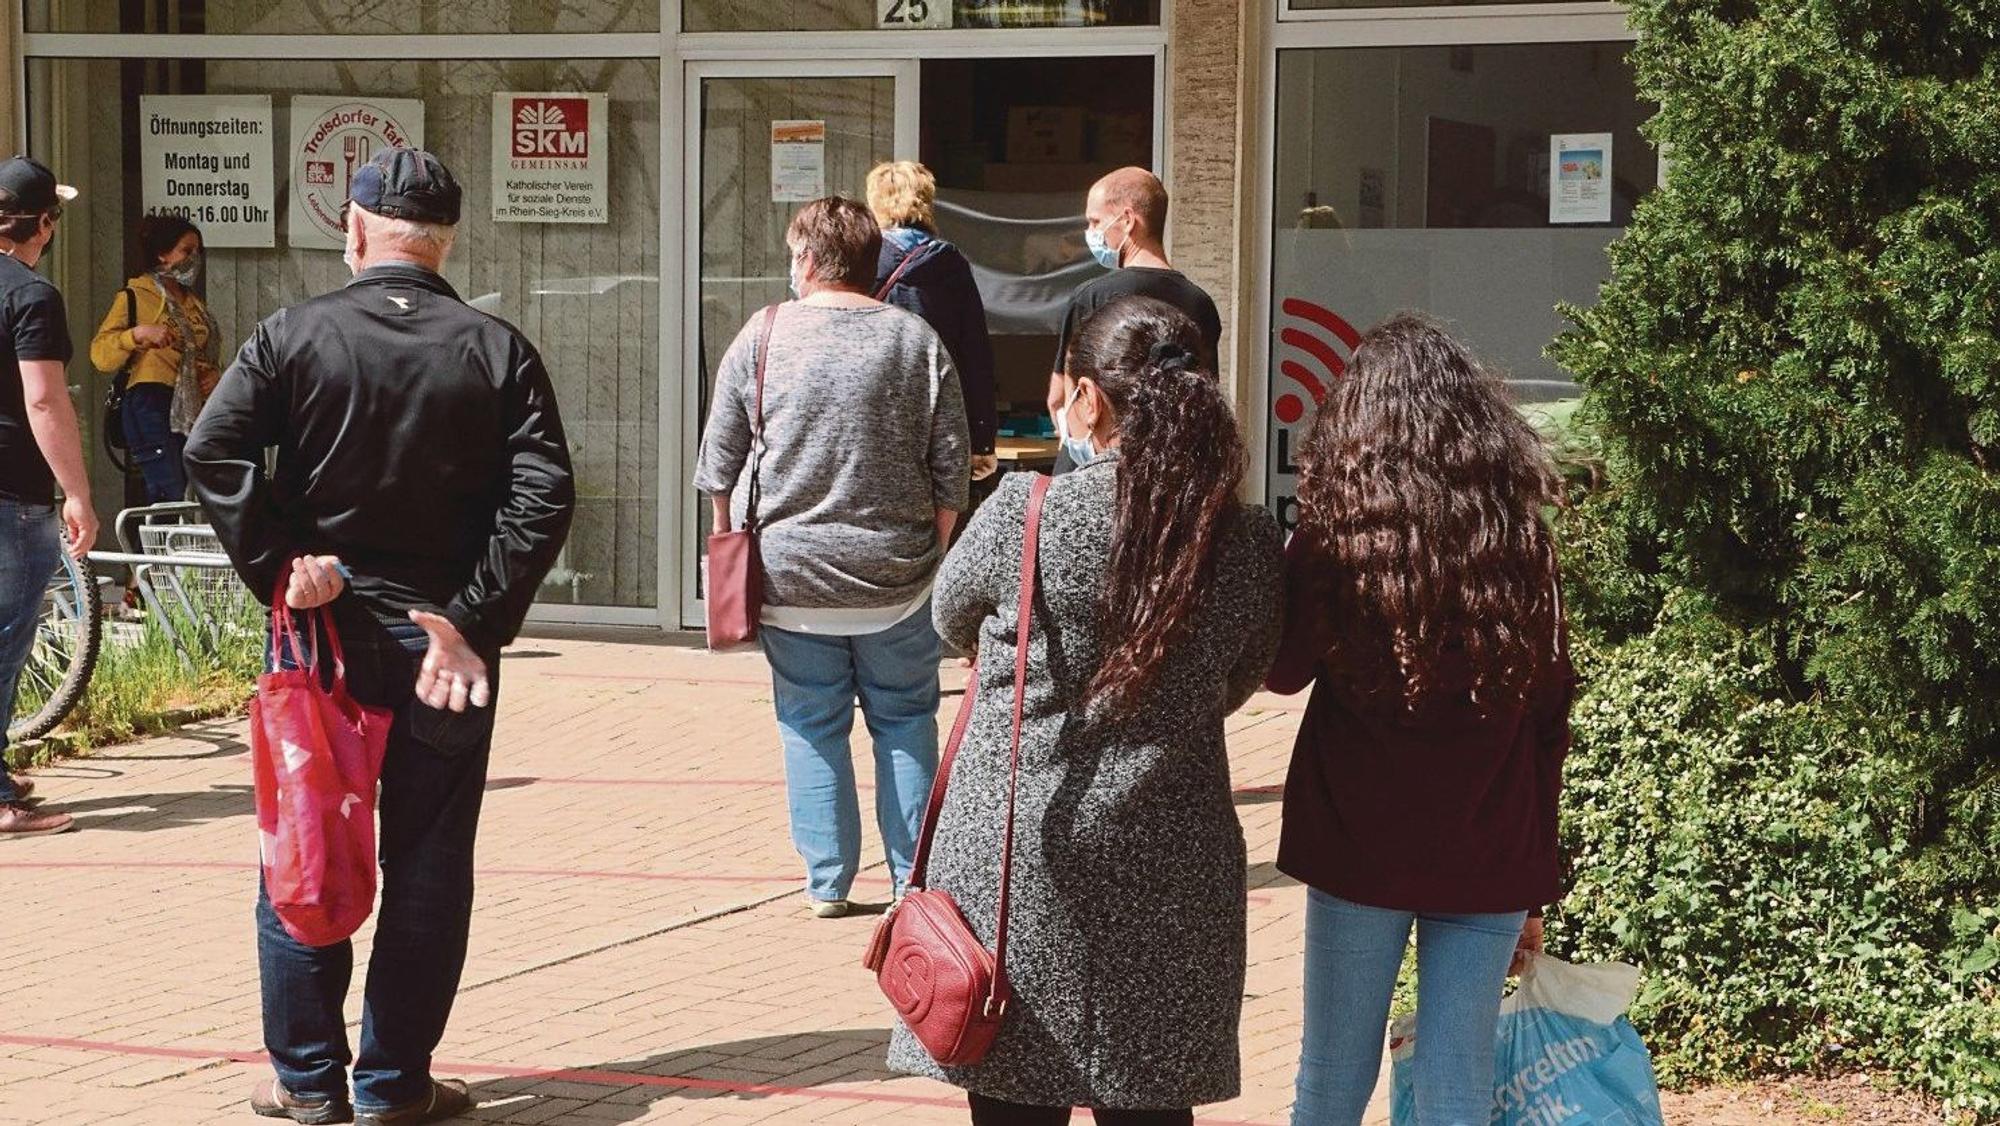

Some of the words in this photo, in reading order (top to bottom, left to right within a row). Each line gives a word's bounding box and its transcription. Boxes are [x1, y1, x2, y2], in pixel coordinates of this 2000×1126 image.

[884, 0, 928, 23] 25
[150, 114, 263, 138] Öffnungszeiten:
[304, 109, 379, 154] Troisdorfer
[382, 120, 405, 148] Taf
[516, 131, 585, 154] SKM
[164, 153, 219, 173] Montag
[223, 153, 250, 170] und
[511, 160, 588, 170] GEMEINSAM
[308, 173, 334, 184] SKM
[506, 181, 562, 191] Katholischer
[563, 181, 594, 191] Verein
[166, 179, 250, 199] Donnerstag
[507, 194, 520, 204] für
[522, 194, 554, 204] soziale
[556, 194, 592, 204] Dienste
[243, 205, 269, 223] Uhr
[496, 208, 507, 216] im
[509, 207, 587, 219] Rhein-Sieg-Kreis
